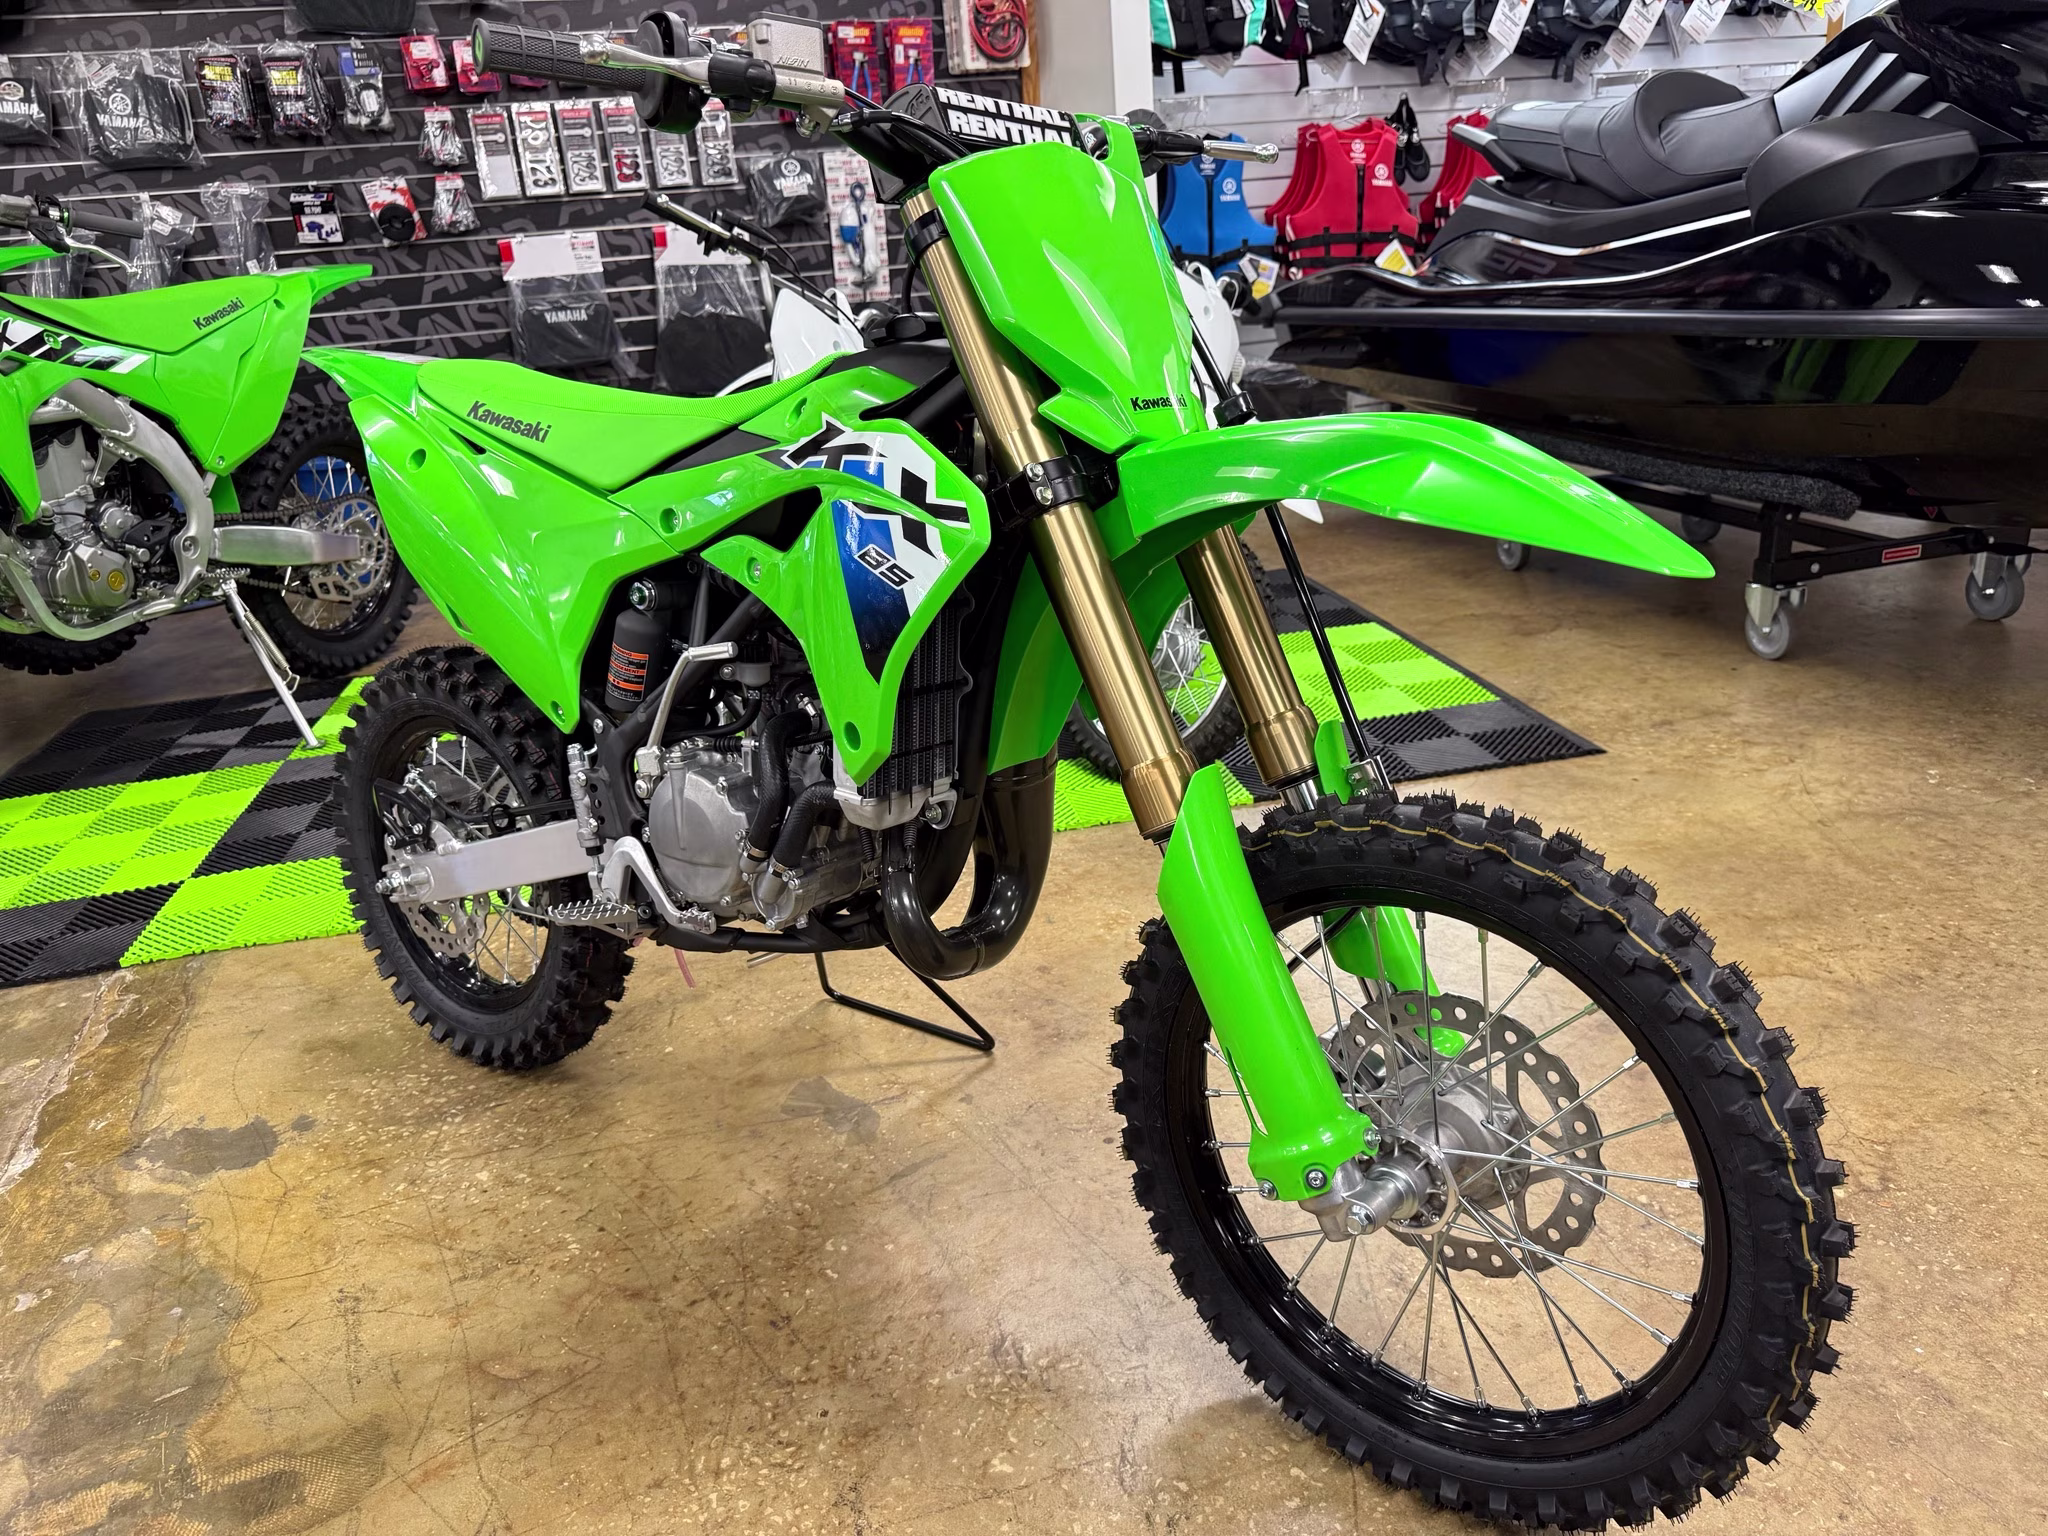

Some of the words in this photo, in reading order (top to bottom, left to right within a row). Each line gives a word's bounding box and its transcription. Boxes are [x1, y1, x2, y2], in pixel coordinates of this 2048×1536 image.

[0, 101, 38, 115] AMAHA
[96, 113, 143, 128] YAMAHA
[193, 298, 245, 331] Kawasaki
[544, 309, 588, 324] YAMAHA
[1129, 394, 1188, 412] Kawaski
[467, 400, 552, 443] Kawasaki
[857, 546, 915, 588] 85
